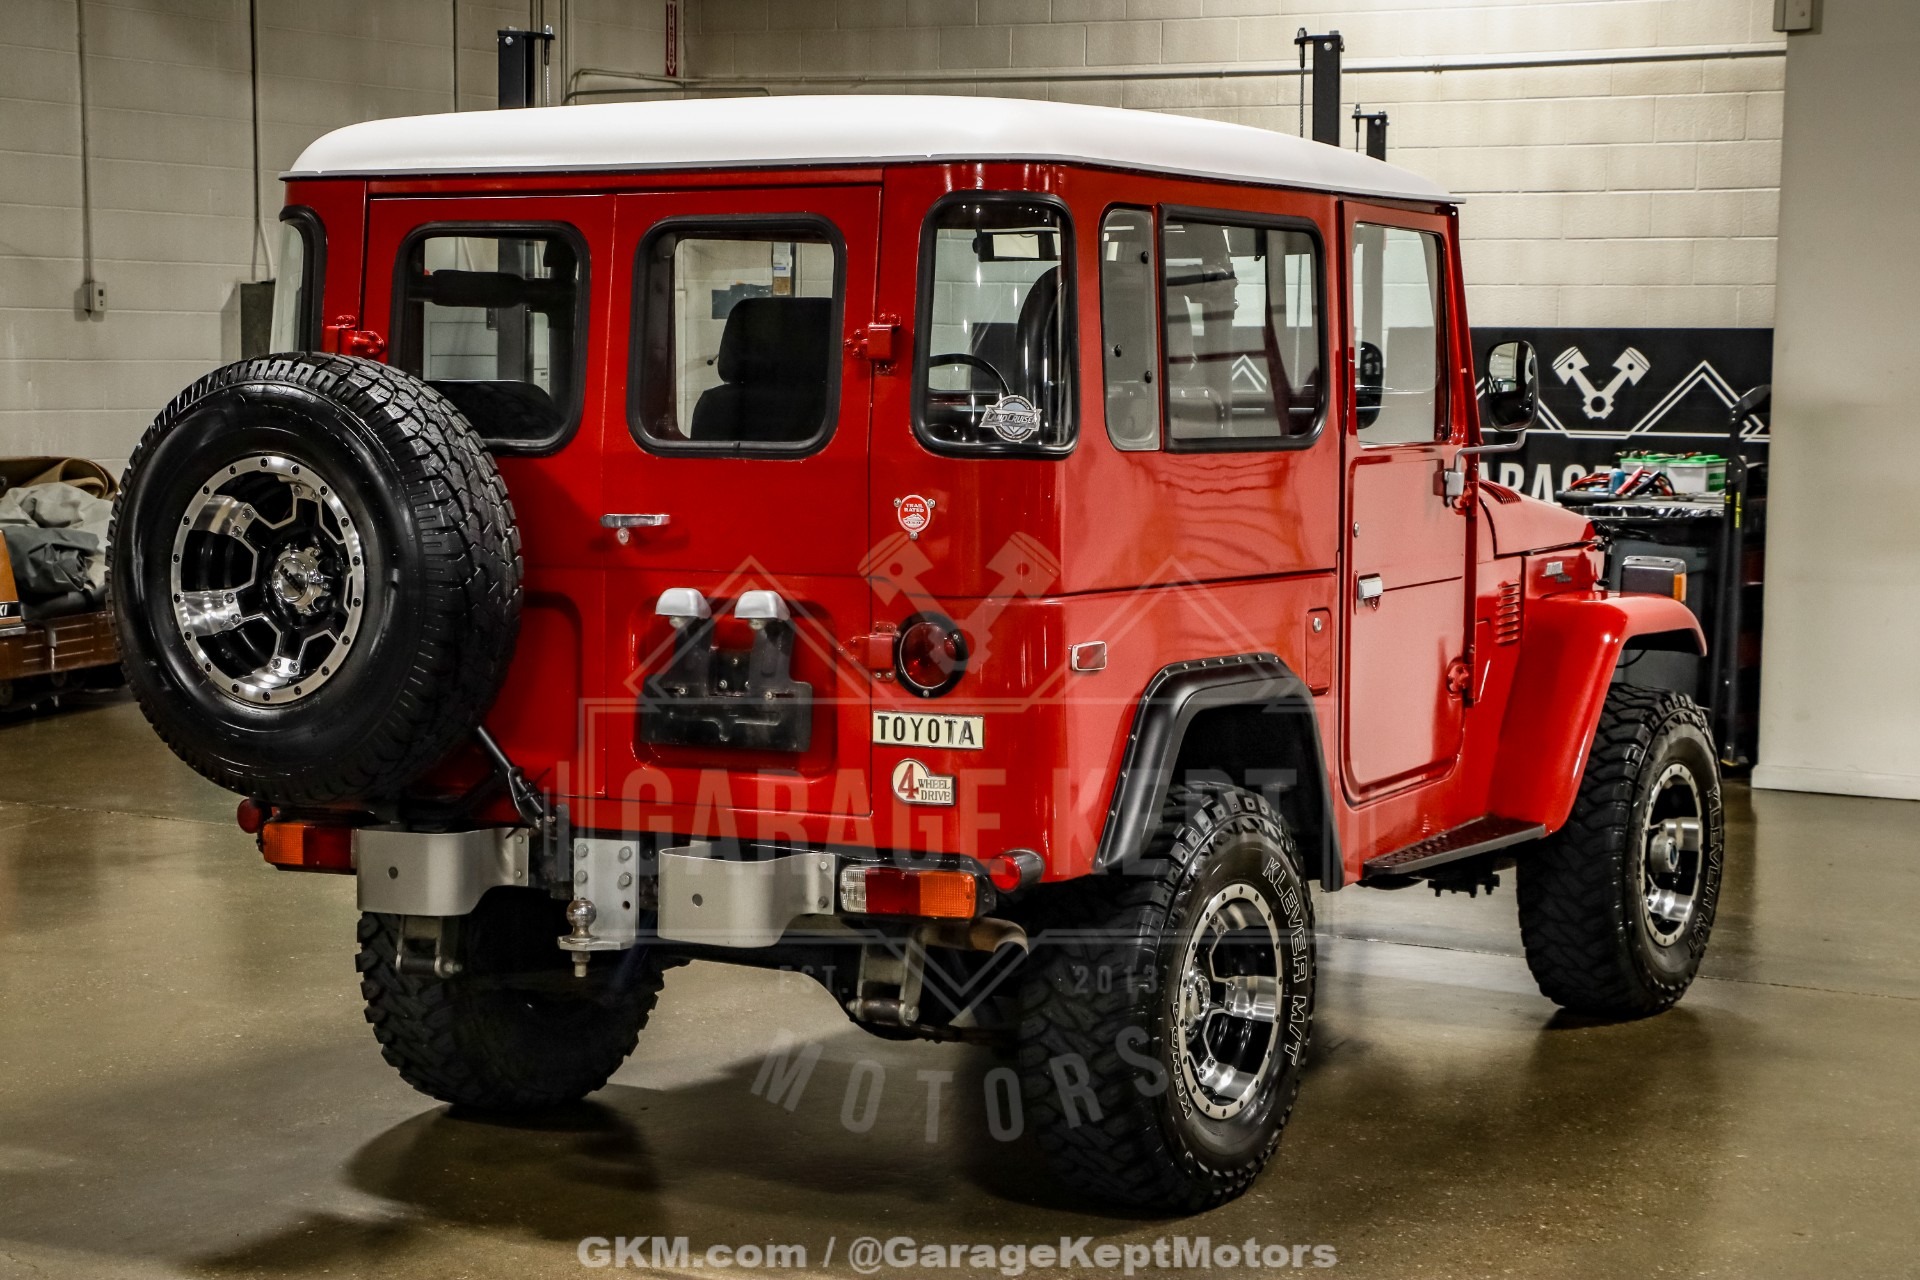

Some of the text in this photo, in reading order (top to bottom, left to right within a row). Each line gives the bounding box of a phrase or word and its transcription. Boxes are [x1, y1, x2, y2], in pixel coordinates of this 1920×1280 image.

[877, 715, 975, 746] TOYOTA
[897, 763, 951, 800] 4 WHEEL
[920, 789, 951, 801] DRIVE
[1262, 857, 1307, 1067] KLEVER M/T
